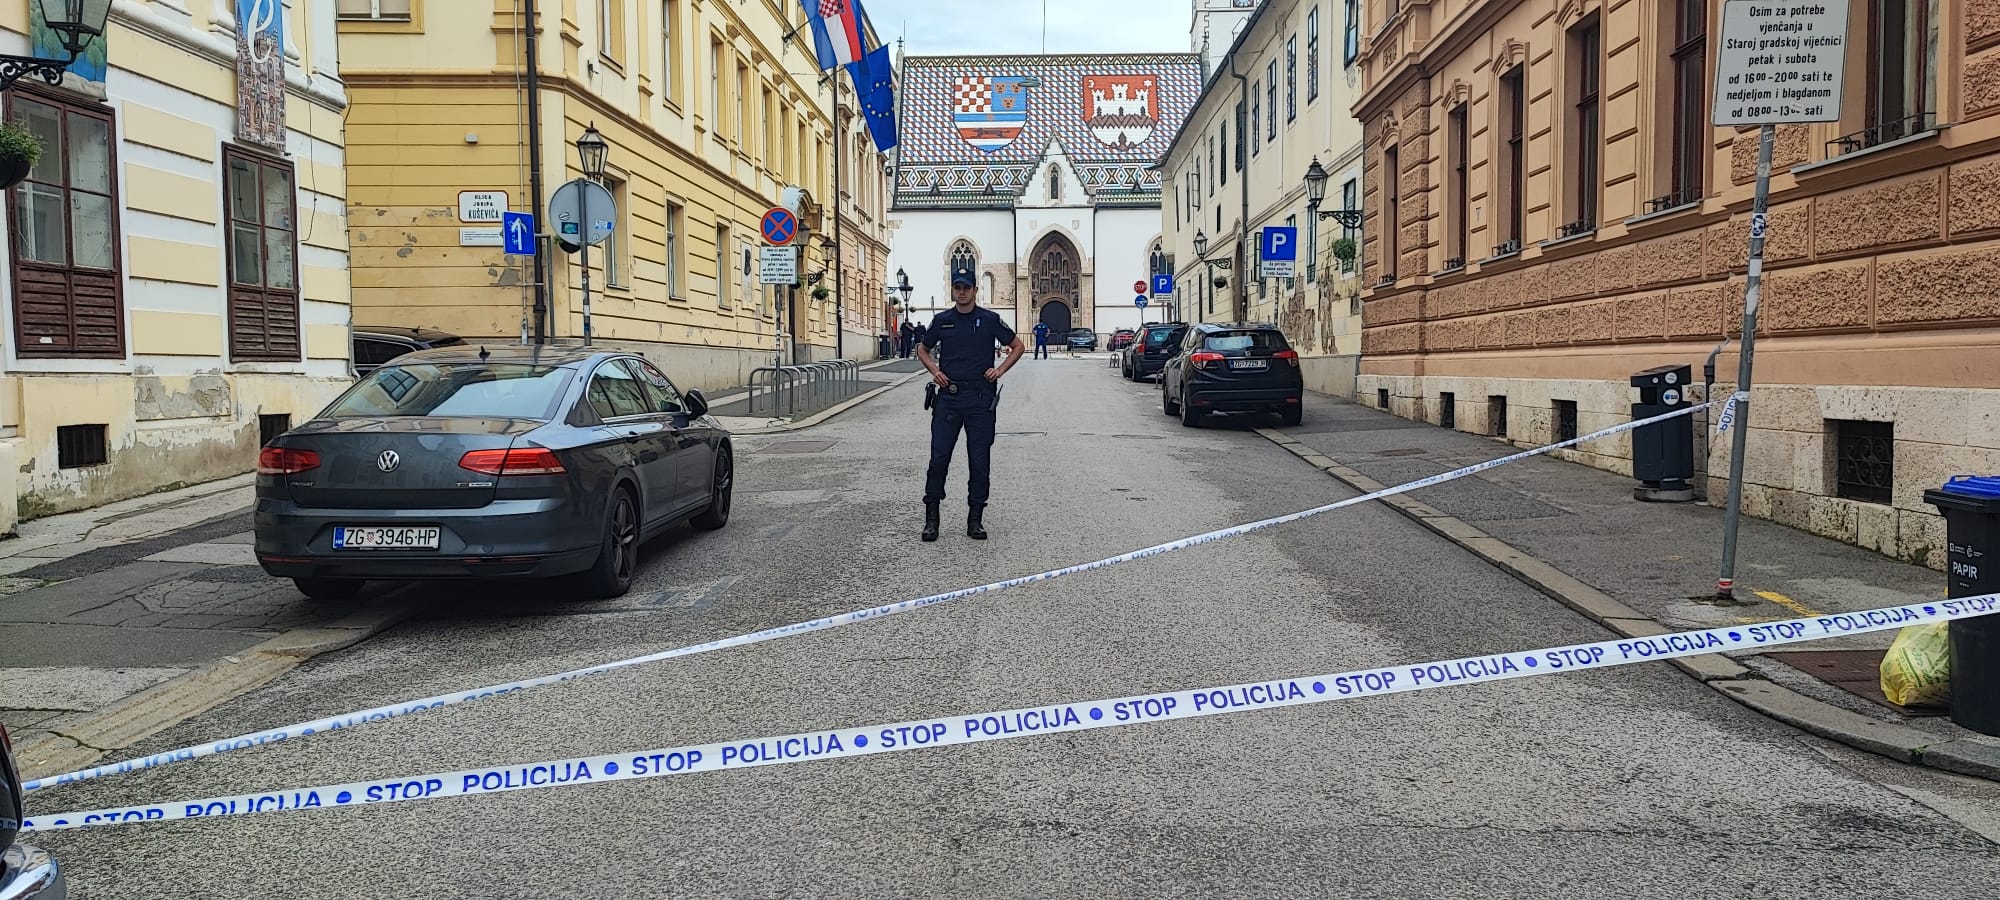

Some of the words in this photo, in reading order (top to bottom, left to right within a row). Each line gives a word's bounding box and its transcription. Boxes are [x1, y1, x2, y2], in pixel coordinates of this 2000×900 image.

[1750, 6, 1772, 17] Osim
[1776, 7, 1787, 16] za
[1790, 4, 1825, 18] potrebe
[1760, 21, 1803, 35] vjenčanja
[1807, 22, 1813, 31] u
[1727, 38, 1757, 51] Staroj
[1759, 37, 1800, 51] gradskoj
[1803, 35, 1842, 49] vijećnici
[1748, 54, 1774, 67] petak
[1778, 54, 1782, 64] i
[1785, 53, 1817, 64] subota
[1728, 74, 1740, 85] od
[1801, 71, 1820, 82] sati
[1823, 72, 1833, 82] te
[1726, 89, 1771, 103] nedjeljom
[1775, 88, 1779, 99] i
[1782, 87, 1831, 101] blagdanom
[1731, 107, 1742, 118] od
[1804, 105, 1823, 116] sati
[1271, 232, 1287, 254] P
[1159, 278, 1168, 290] P
[345, 529, 365, 545] ZG
[1953, 561, 1977, 580] PAPIR
[366, 779, 443, 801] STOP
[462, 761, 592, 793] POLICIJA
[632, 750, 703, 772] STOP
[721, 733, 845, 766] POLICIJA
[880, 723, 948, 749] STOP
[965, 707, 1081, 738] POLICIJA
[1113, 696, 1178, 721] STOP
[1193, 681, 1306, 712] POLICIJA
[1335, 671, 1396, 695] STOP
[1410, 656, 1520, 686] POLICIJA
[1546, 646, 1605, 669] STOP
[1617, 631, 1724, 659] POLICIJA
[1748, 622, 1806, 642] STOP
[1817, 607, 1920, 634] POLICIJA
[1942, 596, 1997, 616] STOP
